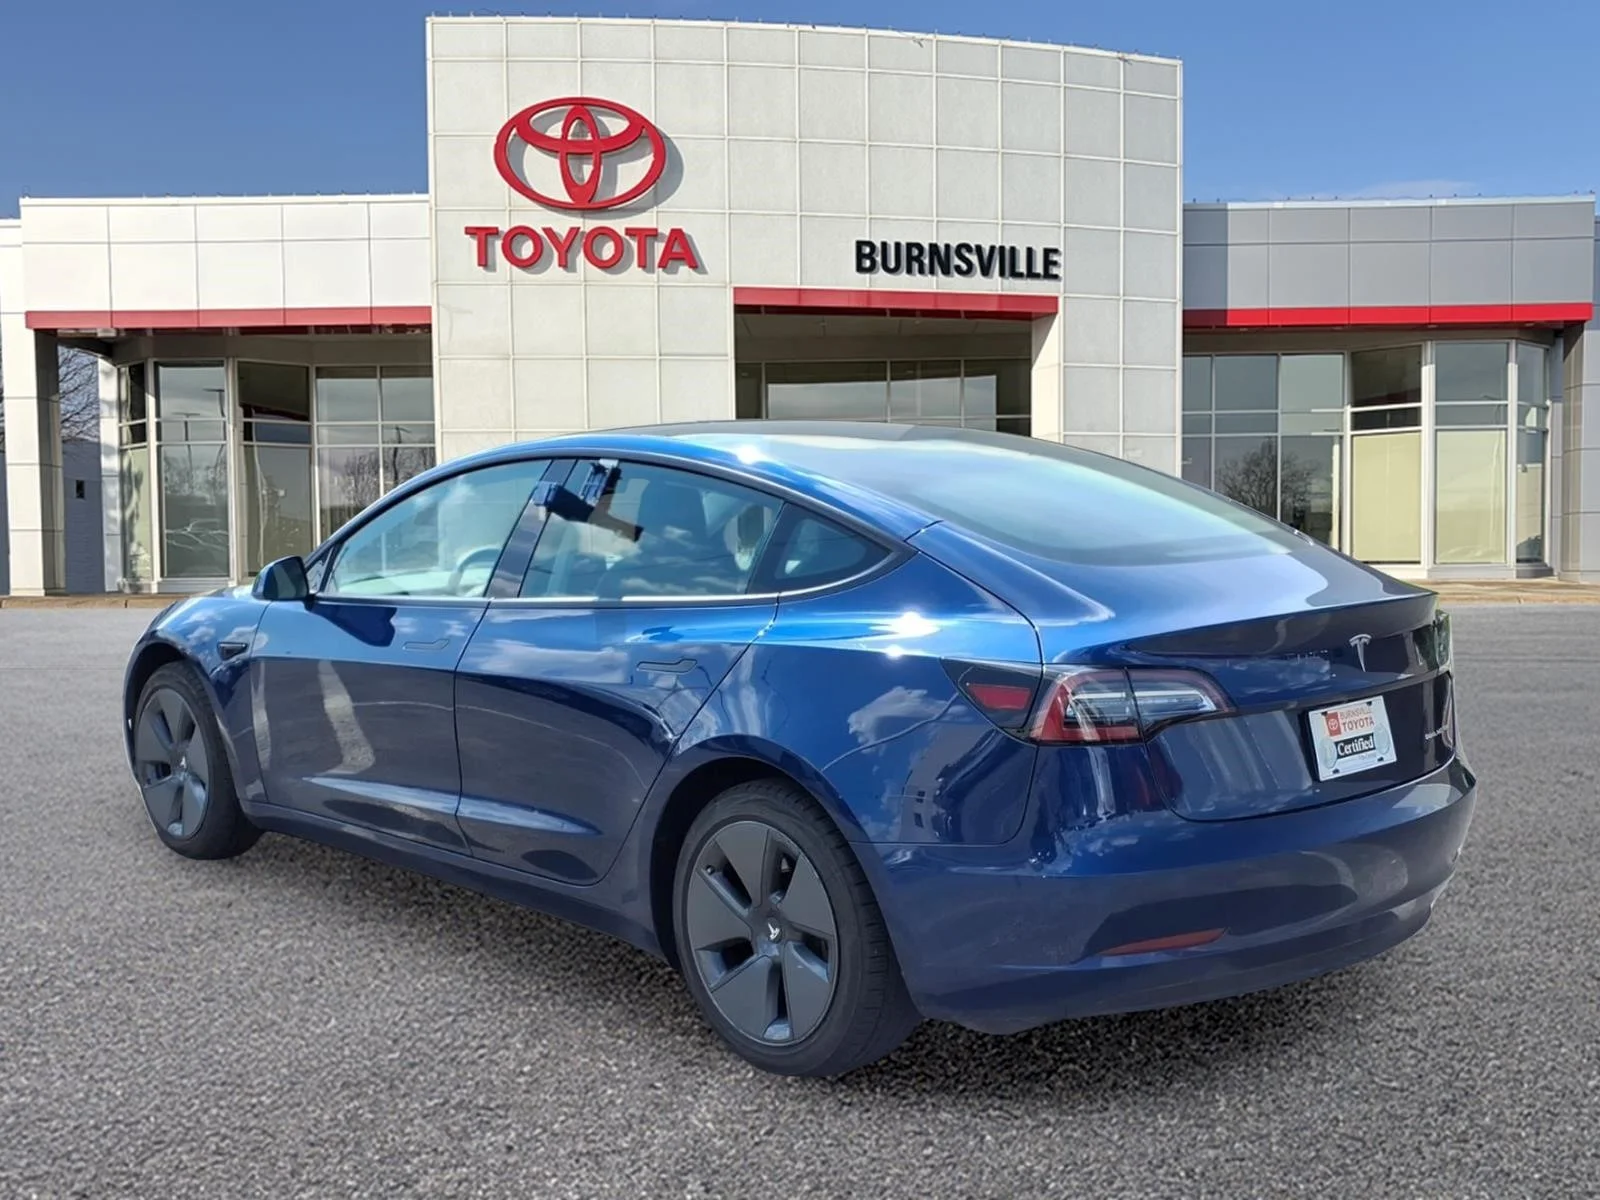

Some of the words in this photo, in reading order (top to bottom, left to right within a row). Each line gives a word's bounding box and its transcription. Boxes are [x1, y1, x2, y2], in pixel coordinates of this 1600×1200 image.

[464, 225, 698, 269] TOYOTA
[855, 240, 1061, 280] BURNSVILLE
[1342, 716, 1375, 732] TOYOTA
[1337, 735, 1374, 756] Certified
